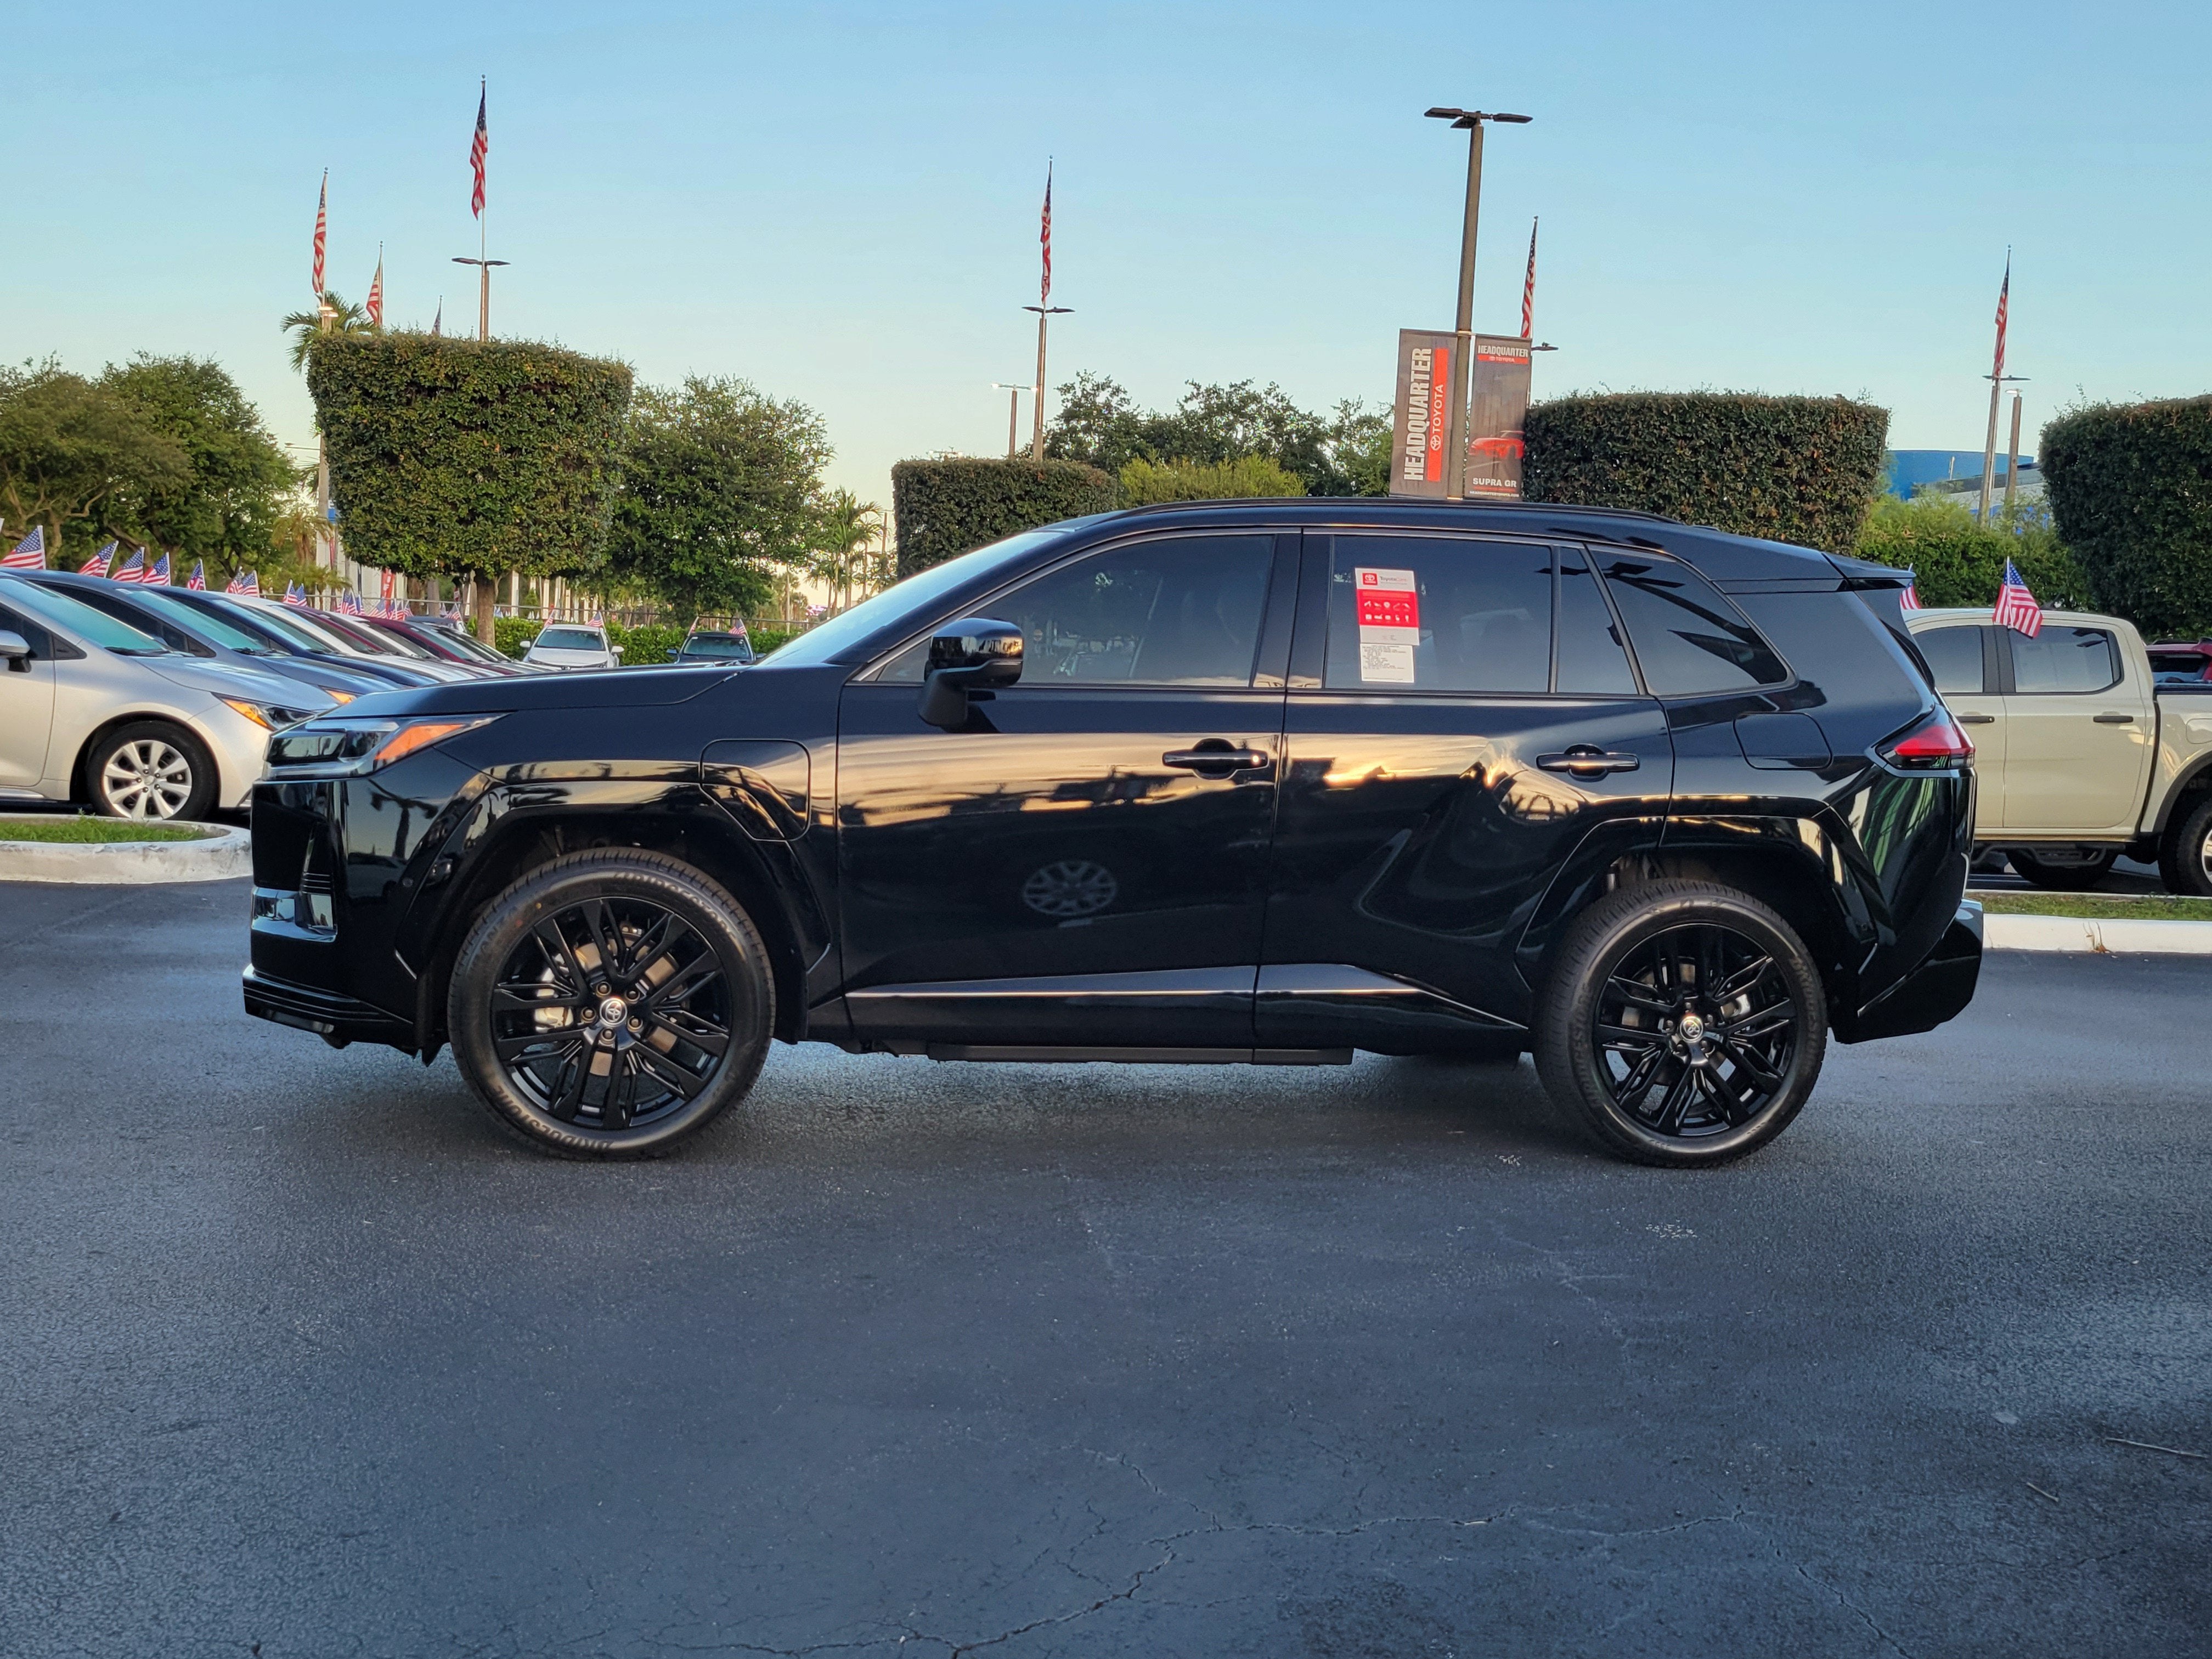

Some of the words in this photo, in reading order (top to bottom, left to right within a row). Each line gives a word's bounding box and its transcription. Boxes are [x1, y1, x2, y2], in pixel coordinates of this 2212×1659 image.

[1477, 345, 1528, 357] HEADQUARTER
[1403, 348, 1432, 481] HEADQUARTER
[1432, 384, 1444, 433] TOYOTA
[1472, 478, 1502, 487] SUPRA
[1504, 479, 1517, 488] GR
